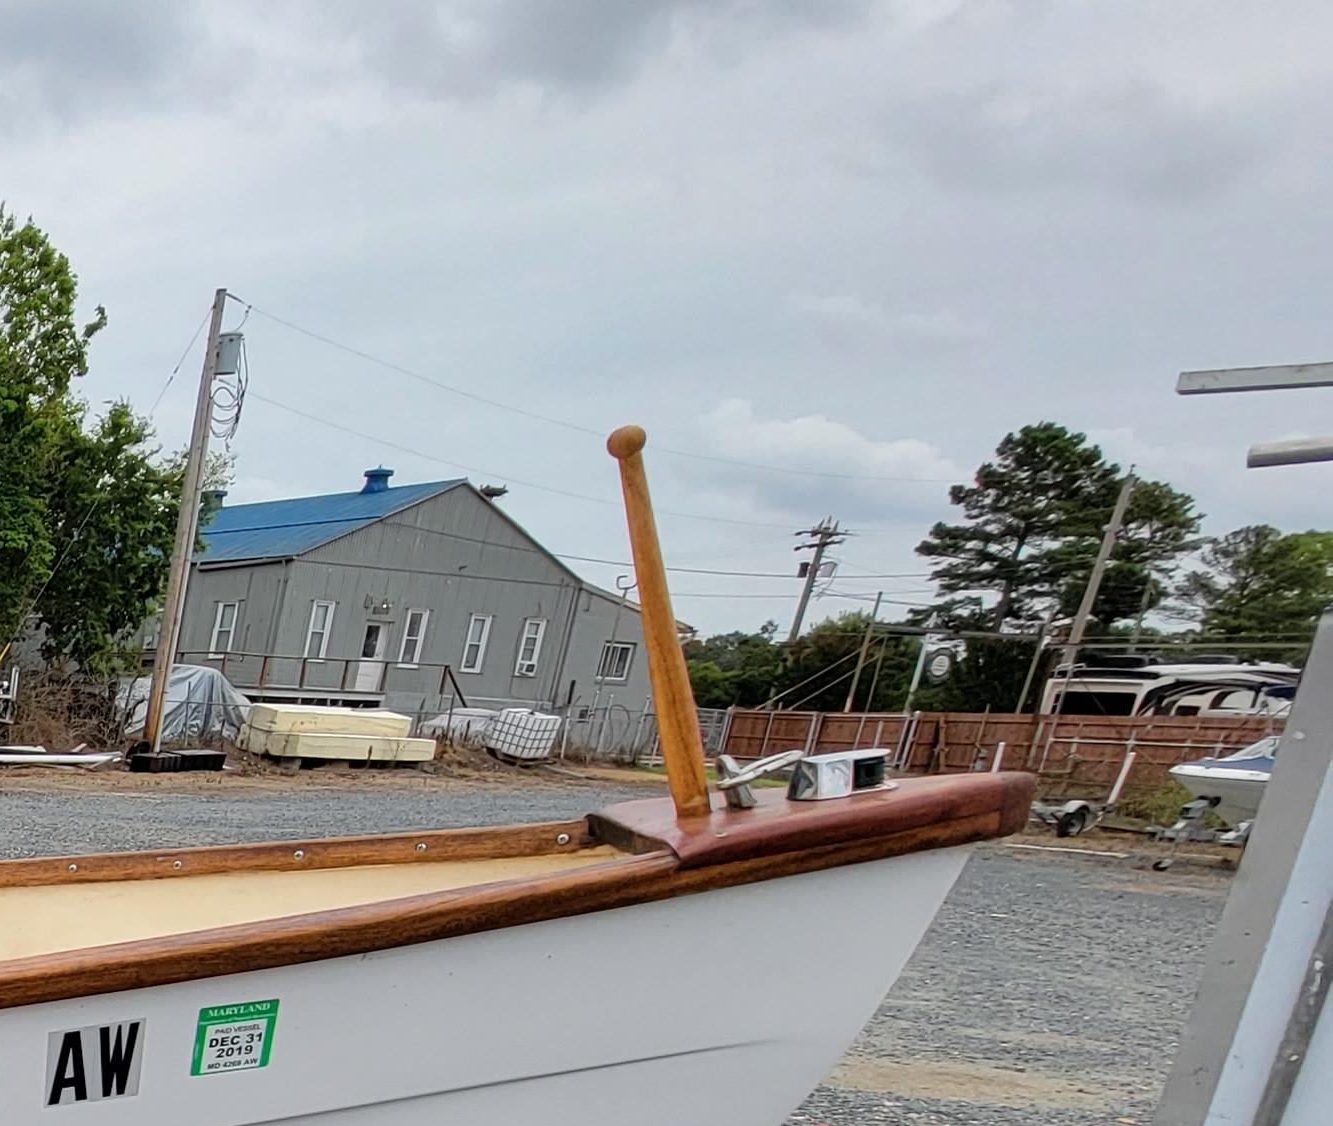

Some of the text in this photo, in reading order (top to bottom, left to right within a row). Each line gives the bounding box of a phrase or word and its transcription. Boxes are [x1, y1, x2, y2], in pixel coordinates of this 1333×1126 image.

[207, 1003, 271, 1017] MARYLAND
[209, 1032, 263, 1048] DEC 31
[215, 1045, 253, 1058] 2019
[47, 1022, 141, 1105] AW
